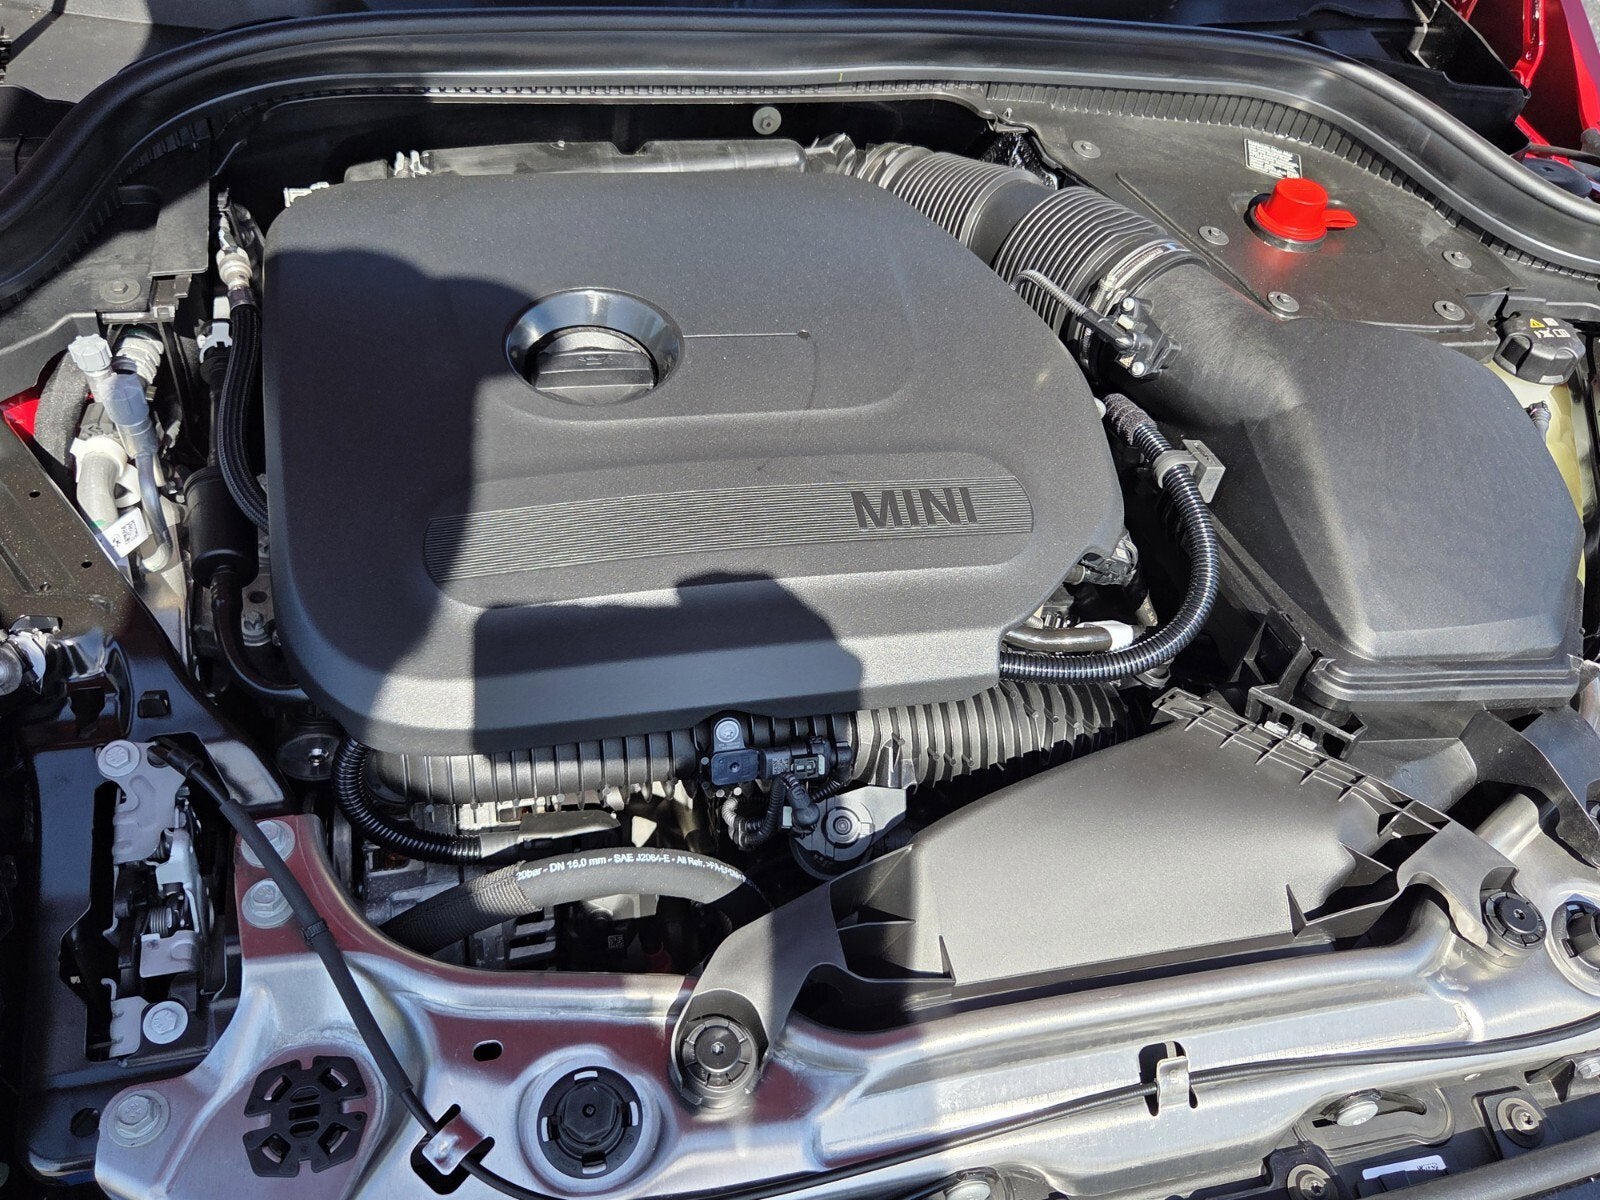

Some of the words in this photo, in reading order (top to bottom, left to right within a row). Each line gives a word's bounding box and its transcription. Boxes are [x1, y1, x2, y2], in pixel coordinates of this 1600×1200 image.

[850, 486, 978, 529] MINI
[549, 862, 565, 873] DN
[588, 856, 607, 866] mm
[613, 853, 634, 864] SAE
[676, 855, 688, 865] All
